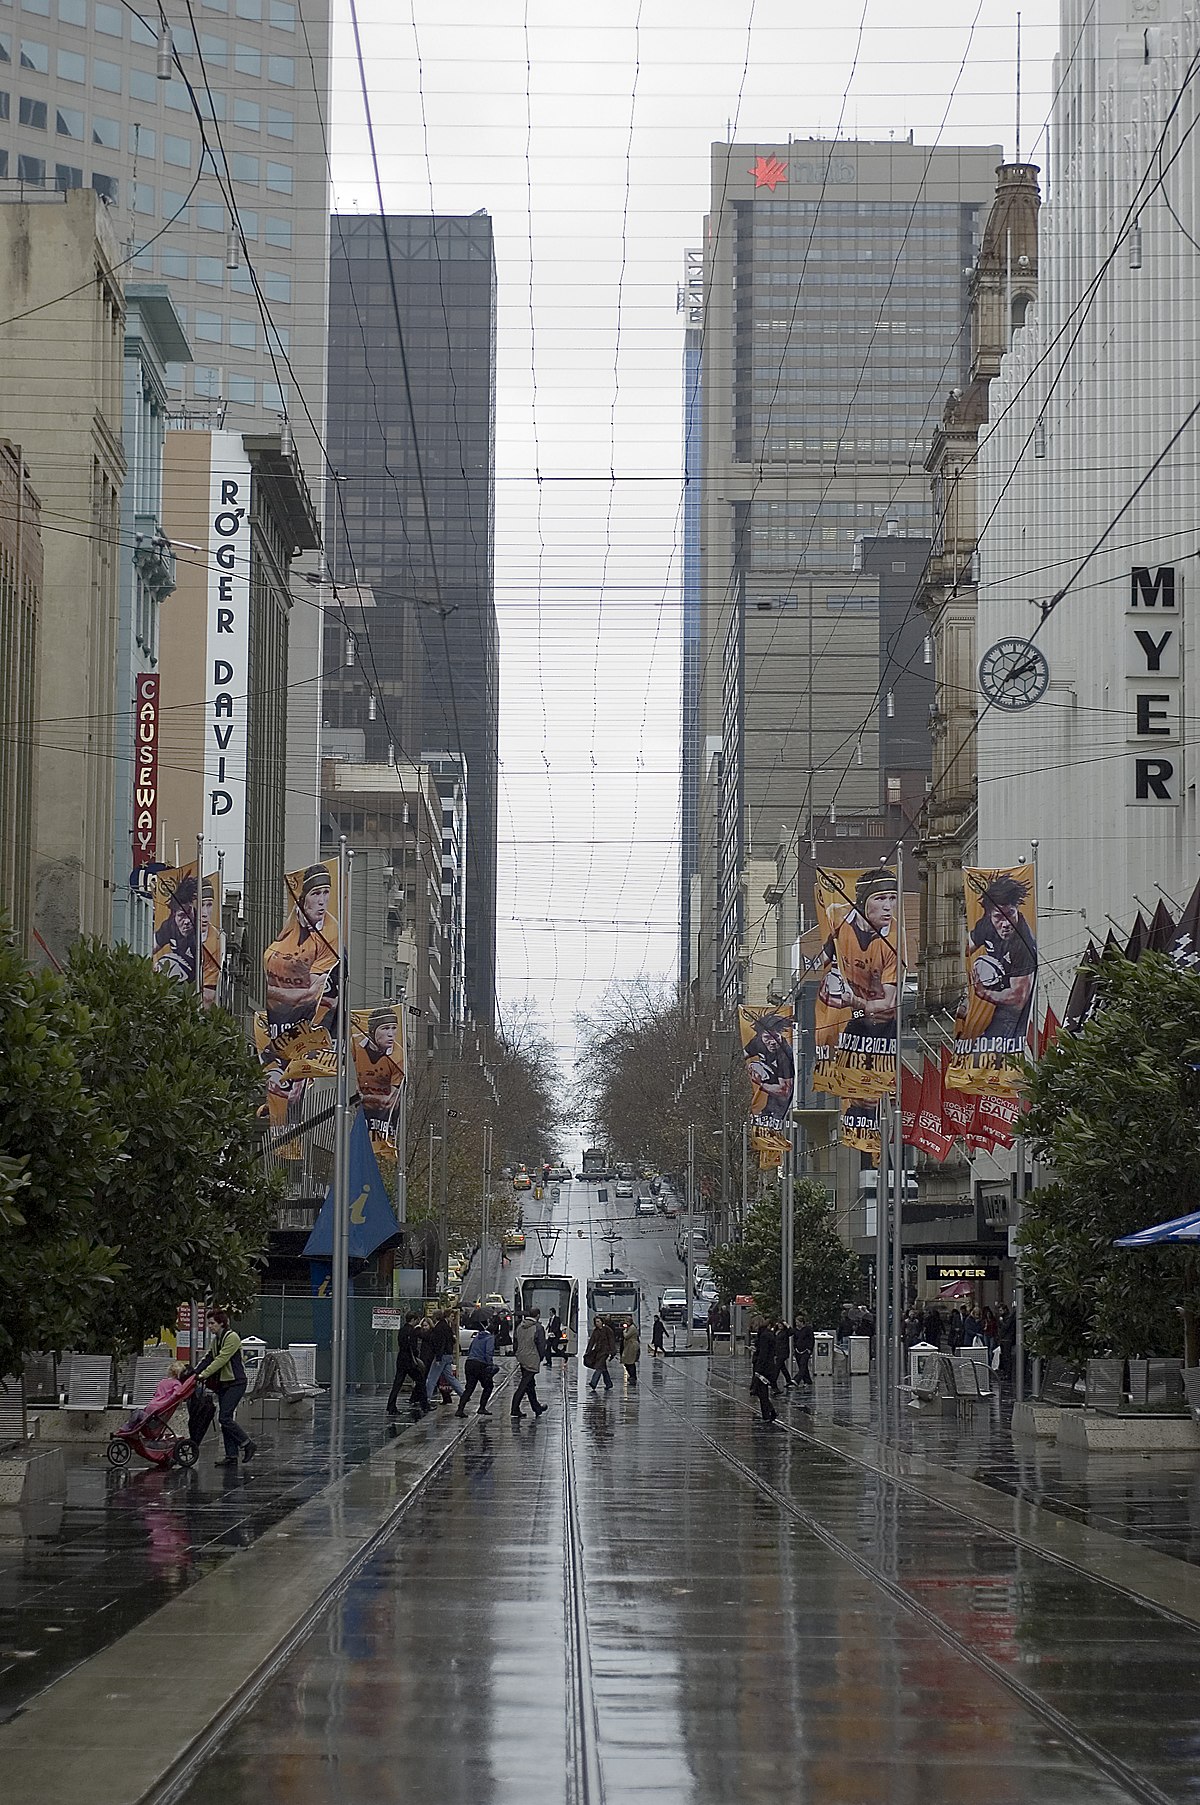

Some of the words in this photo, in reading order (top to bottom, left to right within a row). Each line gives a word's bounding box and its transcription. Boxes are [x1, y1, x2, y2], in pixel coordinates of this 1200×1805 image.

[794, 160, 856, 183] nab
[214, 480, 246, 633] ROGER
[209, 660, 234, 815] DAVID
[1131, 567, 1174, 799] MYER
[136, 680, 156, 850] CAUSEWAY
[939, 1269, 986, 1278] MYER
